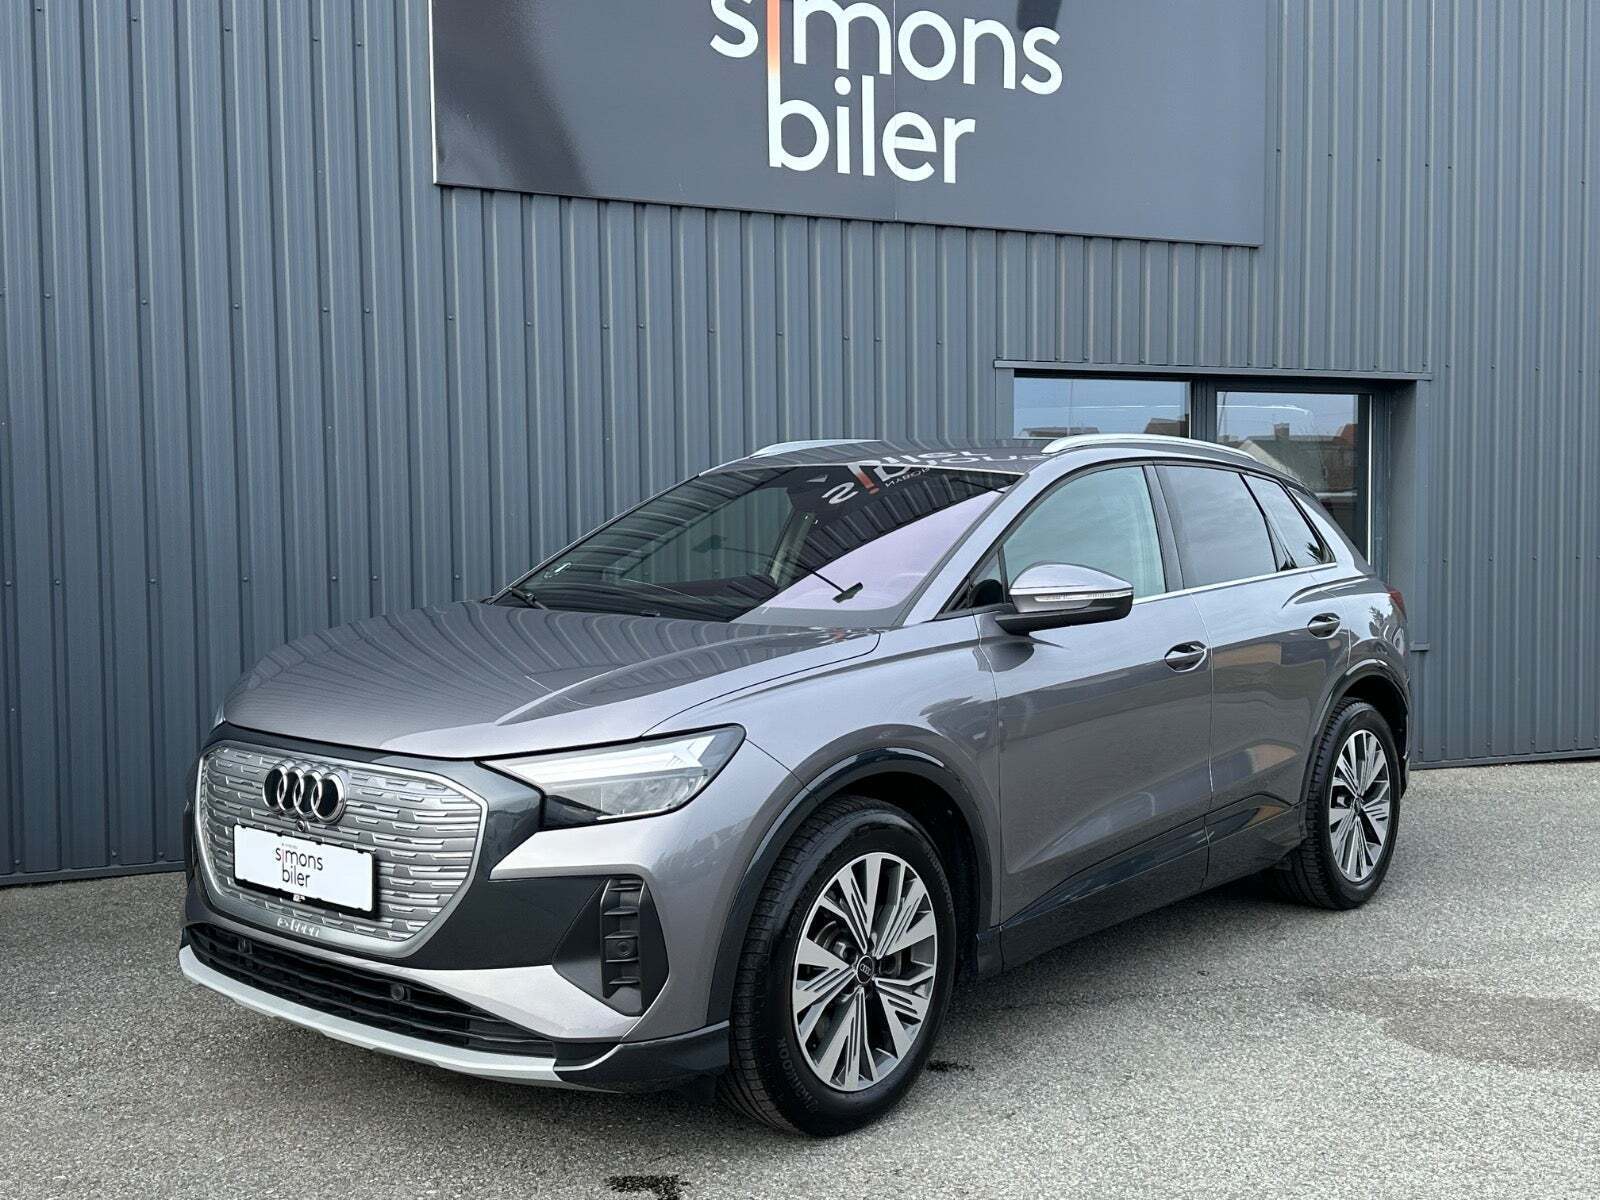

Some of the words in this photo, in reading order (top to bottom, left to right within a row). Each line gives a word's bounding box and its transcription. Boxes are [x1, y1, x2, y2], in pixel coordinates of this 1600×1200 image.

[710, 0, 1063, 95] simons
[767, 75, 976, 184] biler
[275, 844, 324, 871] simons
[282, 864, 311, 888] biler
